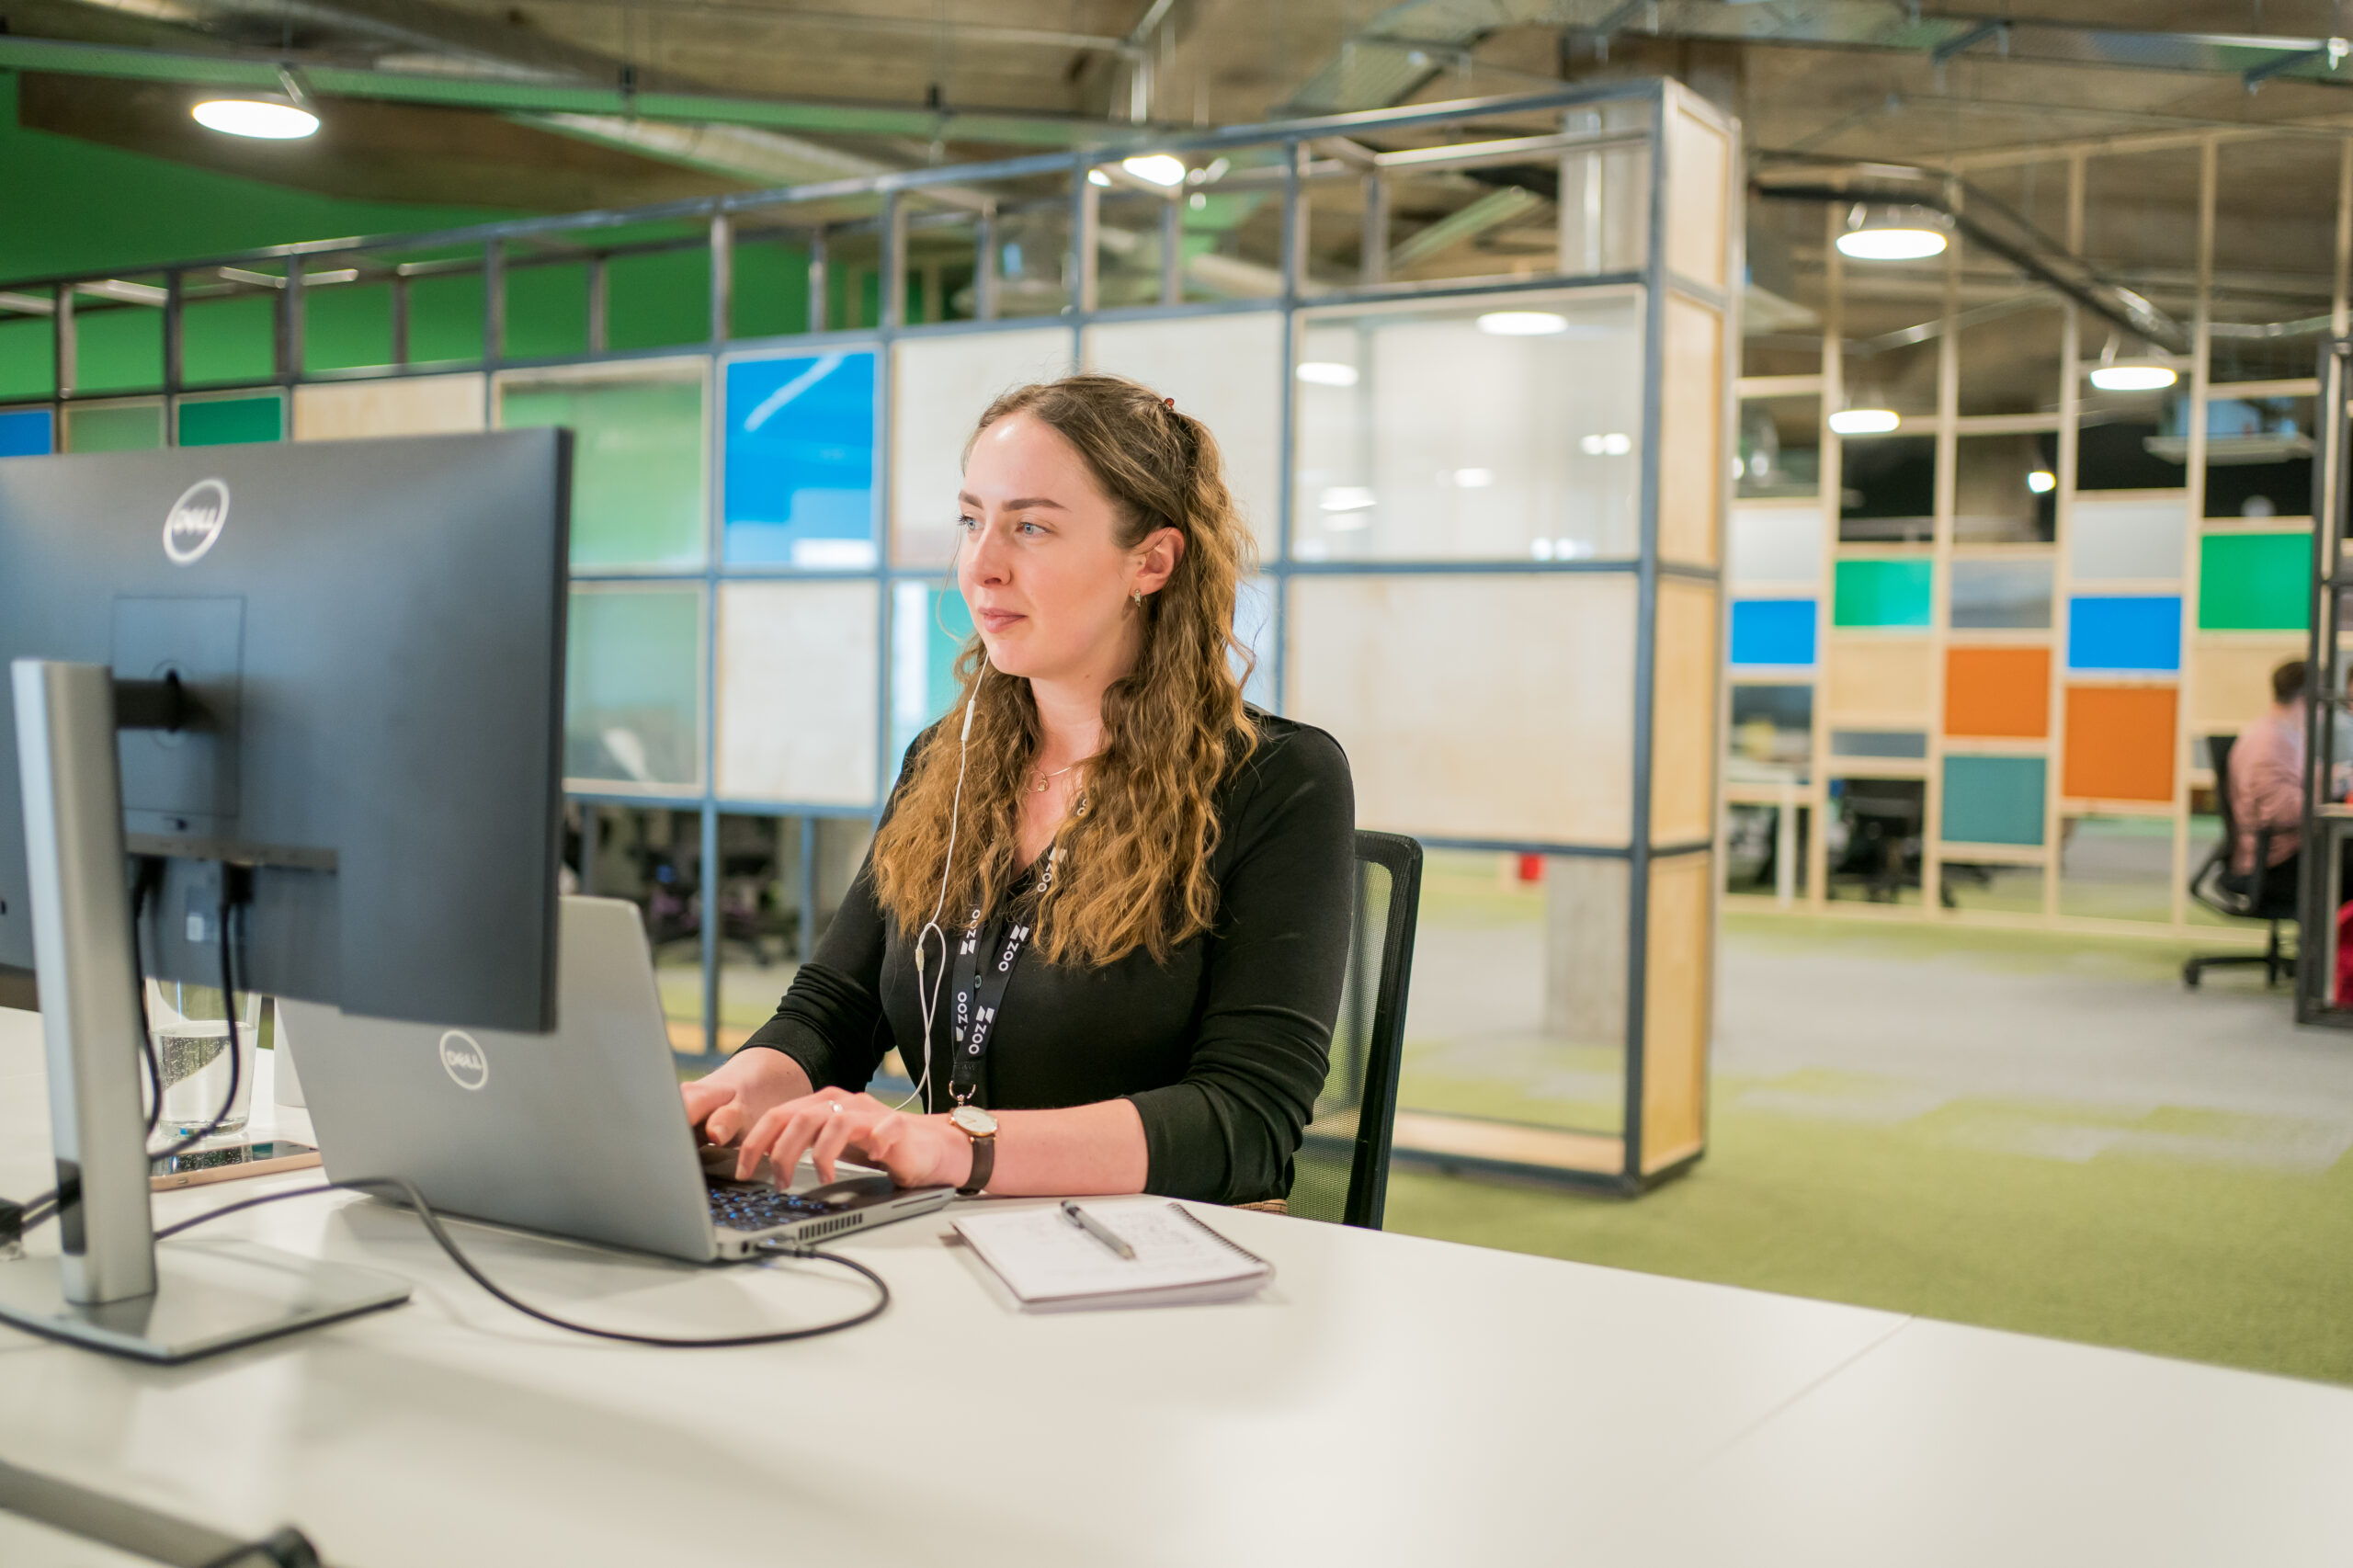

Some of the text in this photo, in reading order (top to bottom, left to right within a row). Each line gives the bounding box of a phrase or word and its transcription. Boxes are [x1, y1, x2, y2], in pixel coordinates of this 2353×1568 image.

[966, 909, 981, 938] ZOO
[998, 941, 1019, 971] ZOO
[957, 992, 969, 1024] ZOO
[968, 1023, 987, 1055] ZOO
